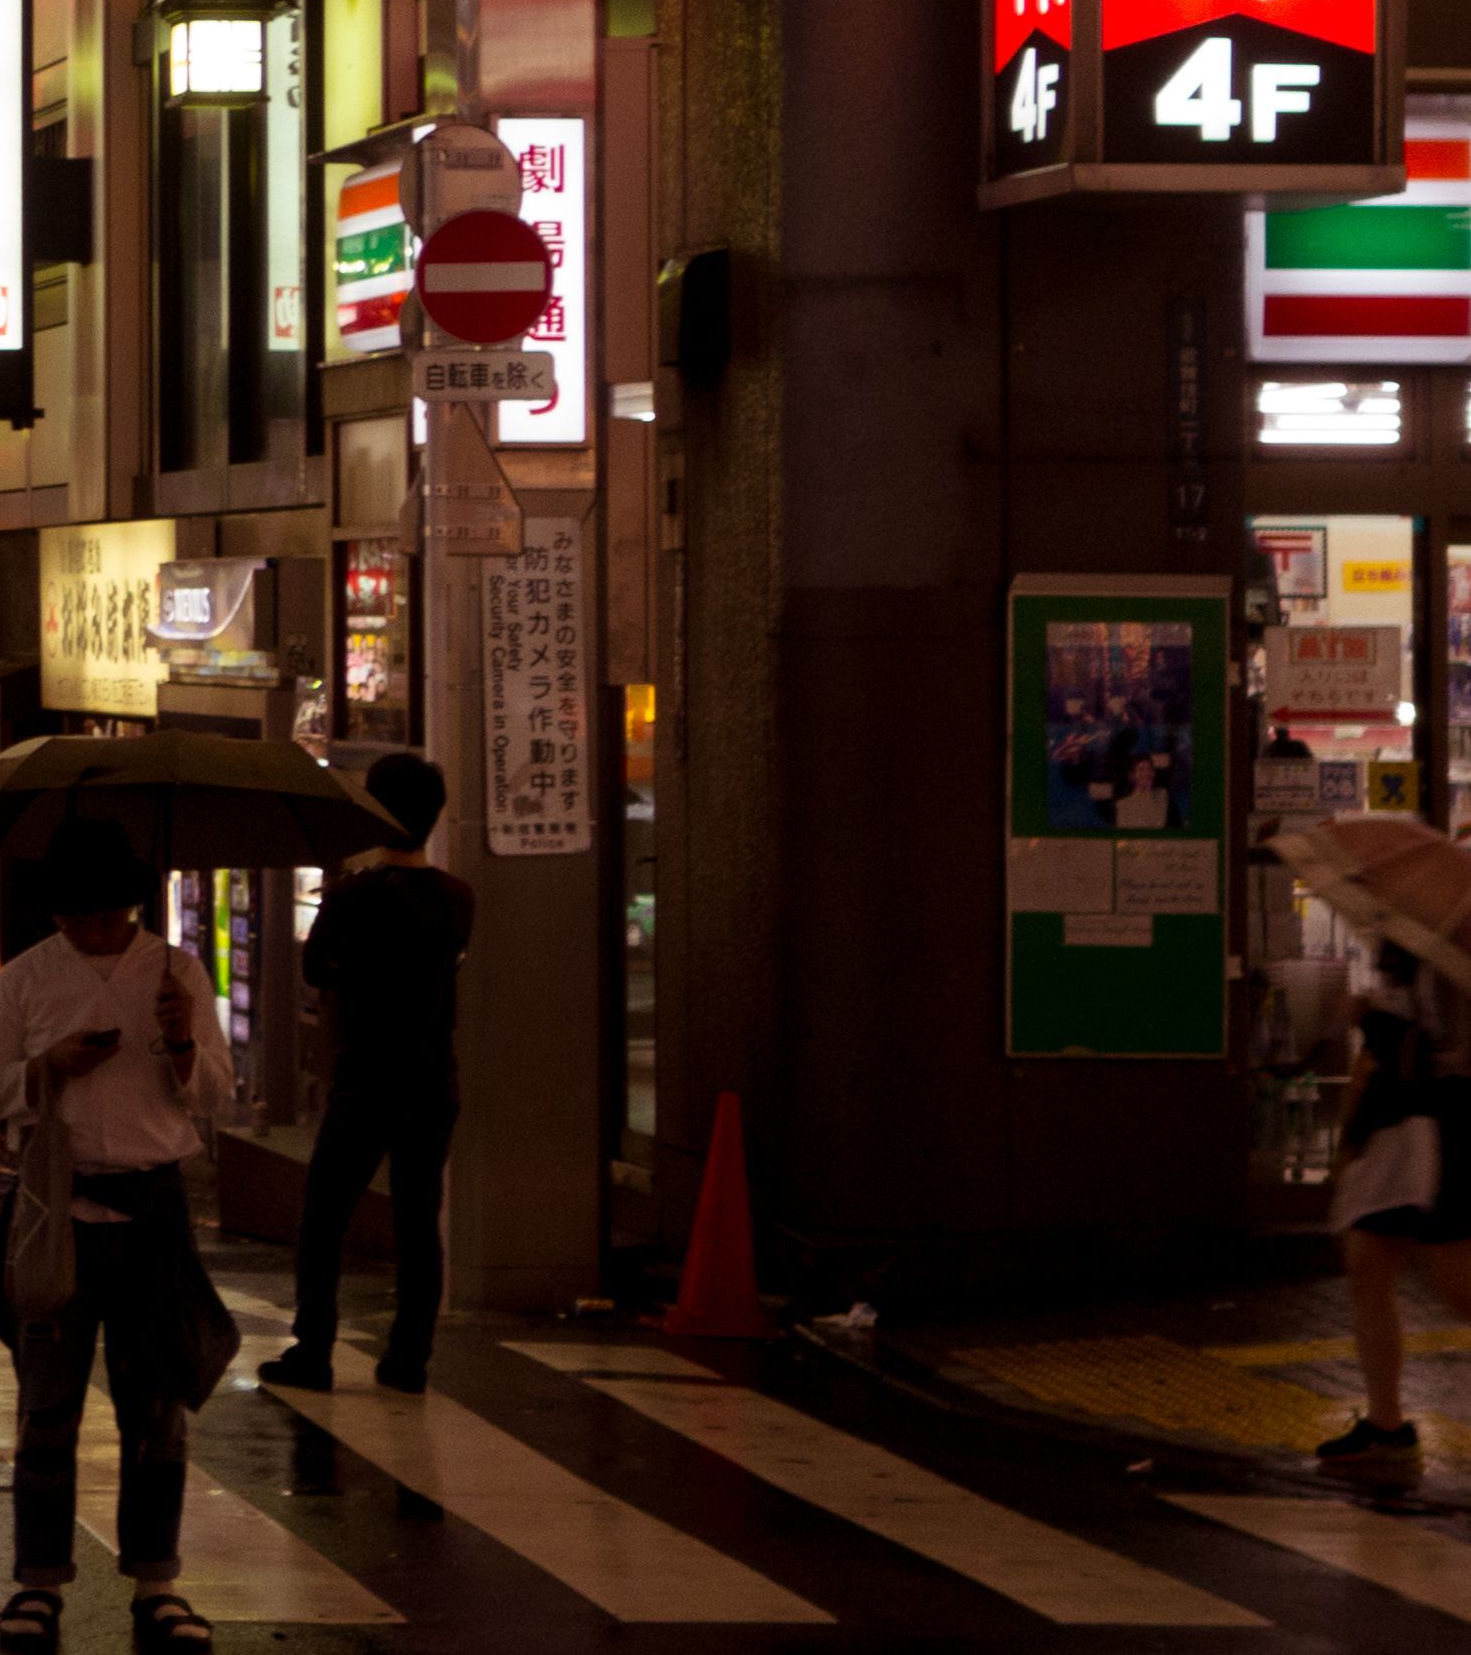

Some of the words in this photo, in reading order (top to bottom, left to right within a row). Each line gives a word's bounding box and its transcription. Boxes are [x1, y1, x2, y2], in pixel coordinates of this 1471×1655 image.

[1010, 47, 1060, 144] 4F
[1154, 36, 1322, 143] 4F
[426, 361, 544, 391] 自転車を除く
[488, 574, 506, 640] Security
[506, 580, 521, 620] Your
[490, 646, 507, 710] Camera
[506, 621, 523, 673] Safety
[524, 545, 556, 798] 防犯カメラ作動中
[552, 530, 580, 811] みなさまの安全を守ります
[493, 715, 507, 732] in
[493, 737, 509, 814] Operation
